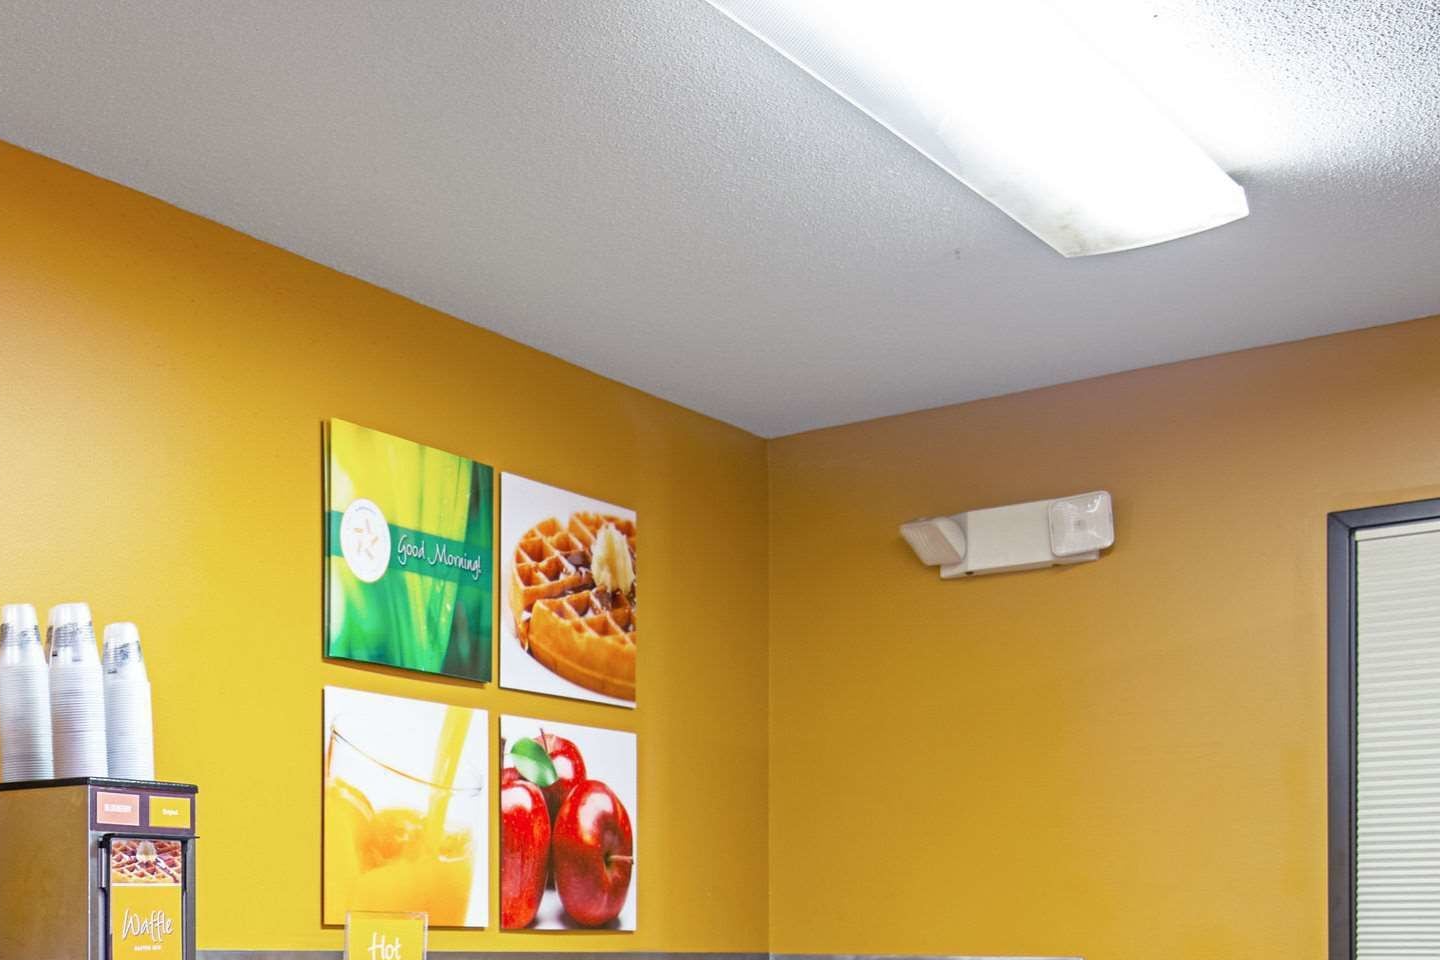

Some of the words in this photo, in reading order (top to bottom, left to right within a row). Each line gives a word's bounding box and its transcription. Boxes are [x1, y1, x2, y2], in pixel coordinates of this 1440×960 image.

[397, 534, 426, 566] Good
[427, 543, 482, 580] Morning!
[122, 909, 174, 943] Waffle
